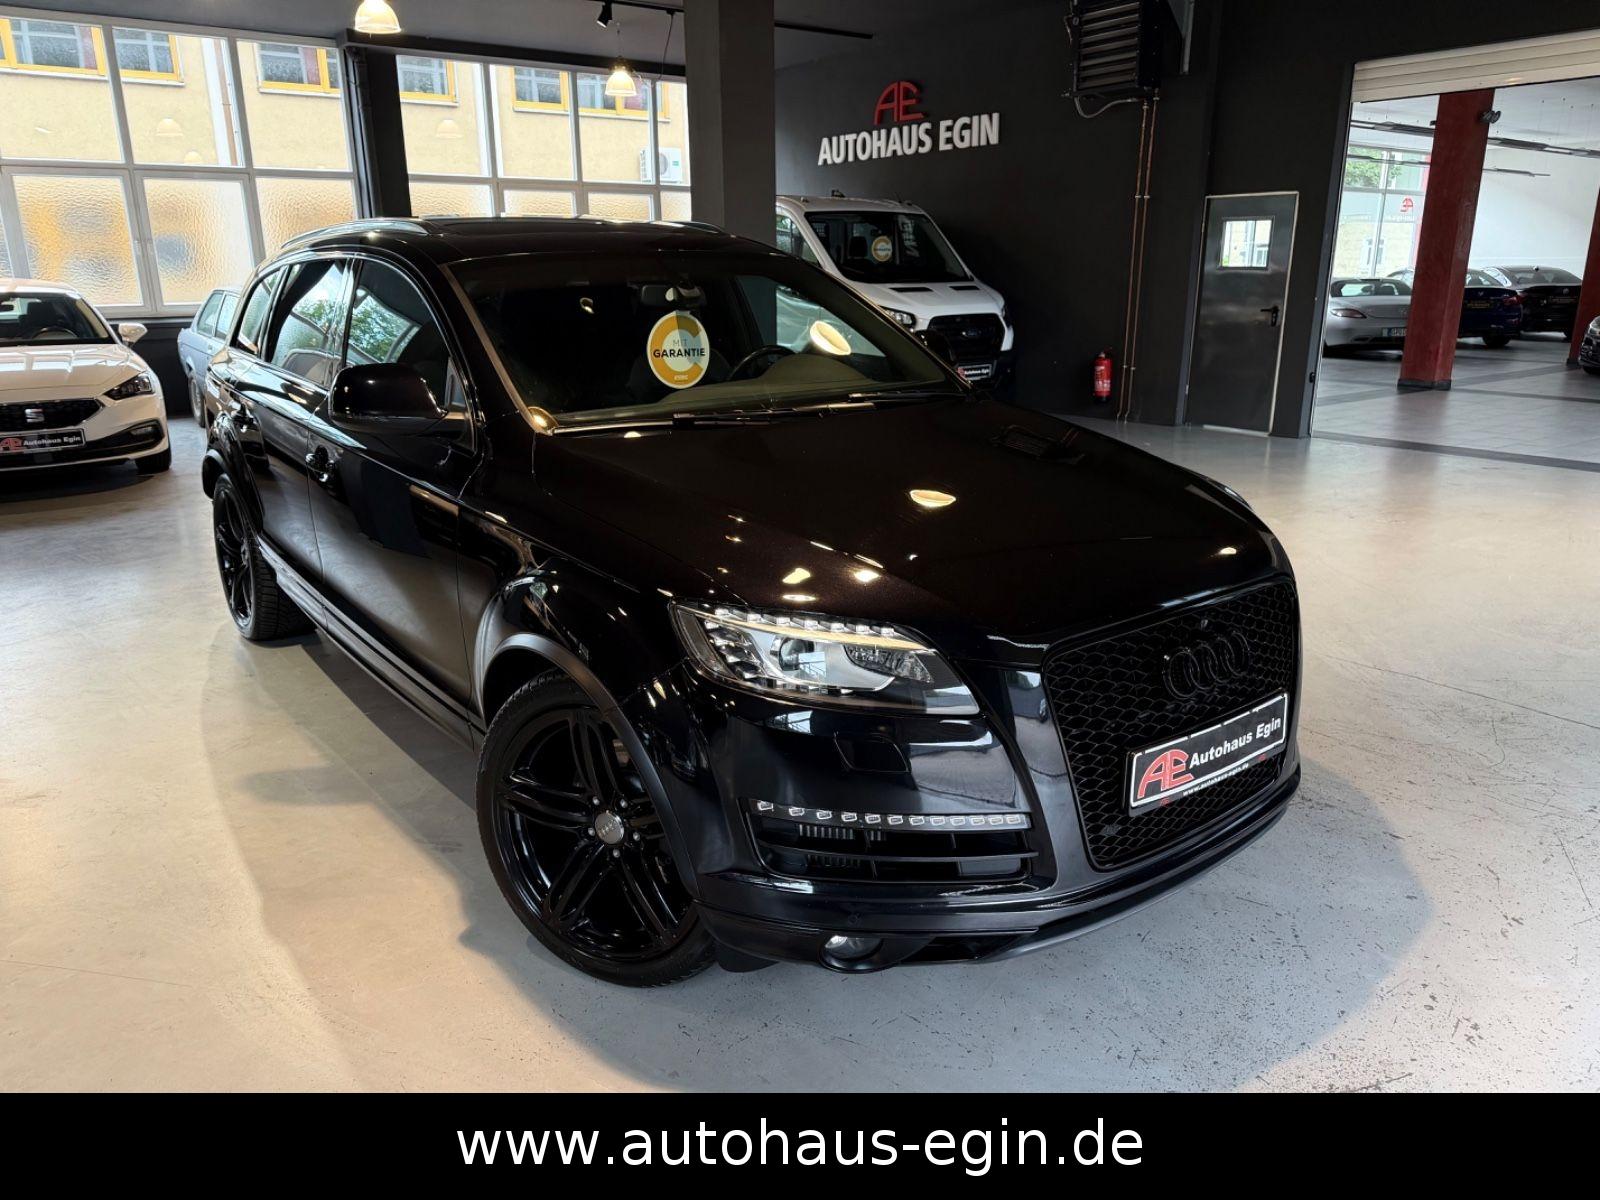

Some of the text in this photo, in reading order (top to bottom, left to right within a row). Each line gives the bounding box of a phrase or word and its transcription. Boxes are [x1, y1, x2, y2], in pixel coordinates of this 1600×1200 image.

[817, 112, 1000, 166] AUTOHAUS EGIN
[653, 347, 706, 358] GARANTIE
[23, 438, 62, 446] Autohaus
[63, 435, 81, 443] Egin
[1189, 732, 1253, 769] Autohaus
[1256, 716, 1281, 739] Egin
